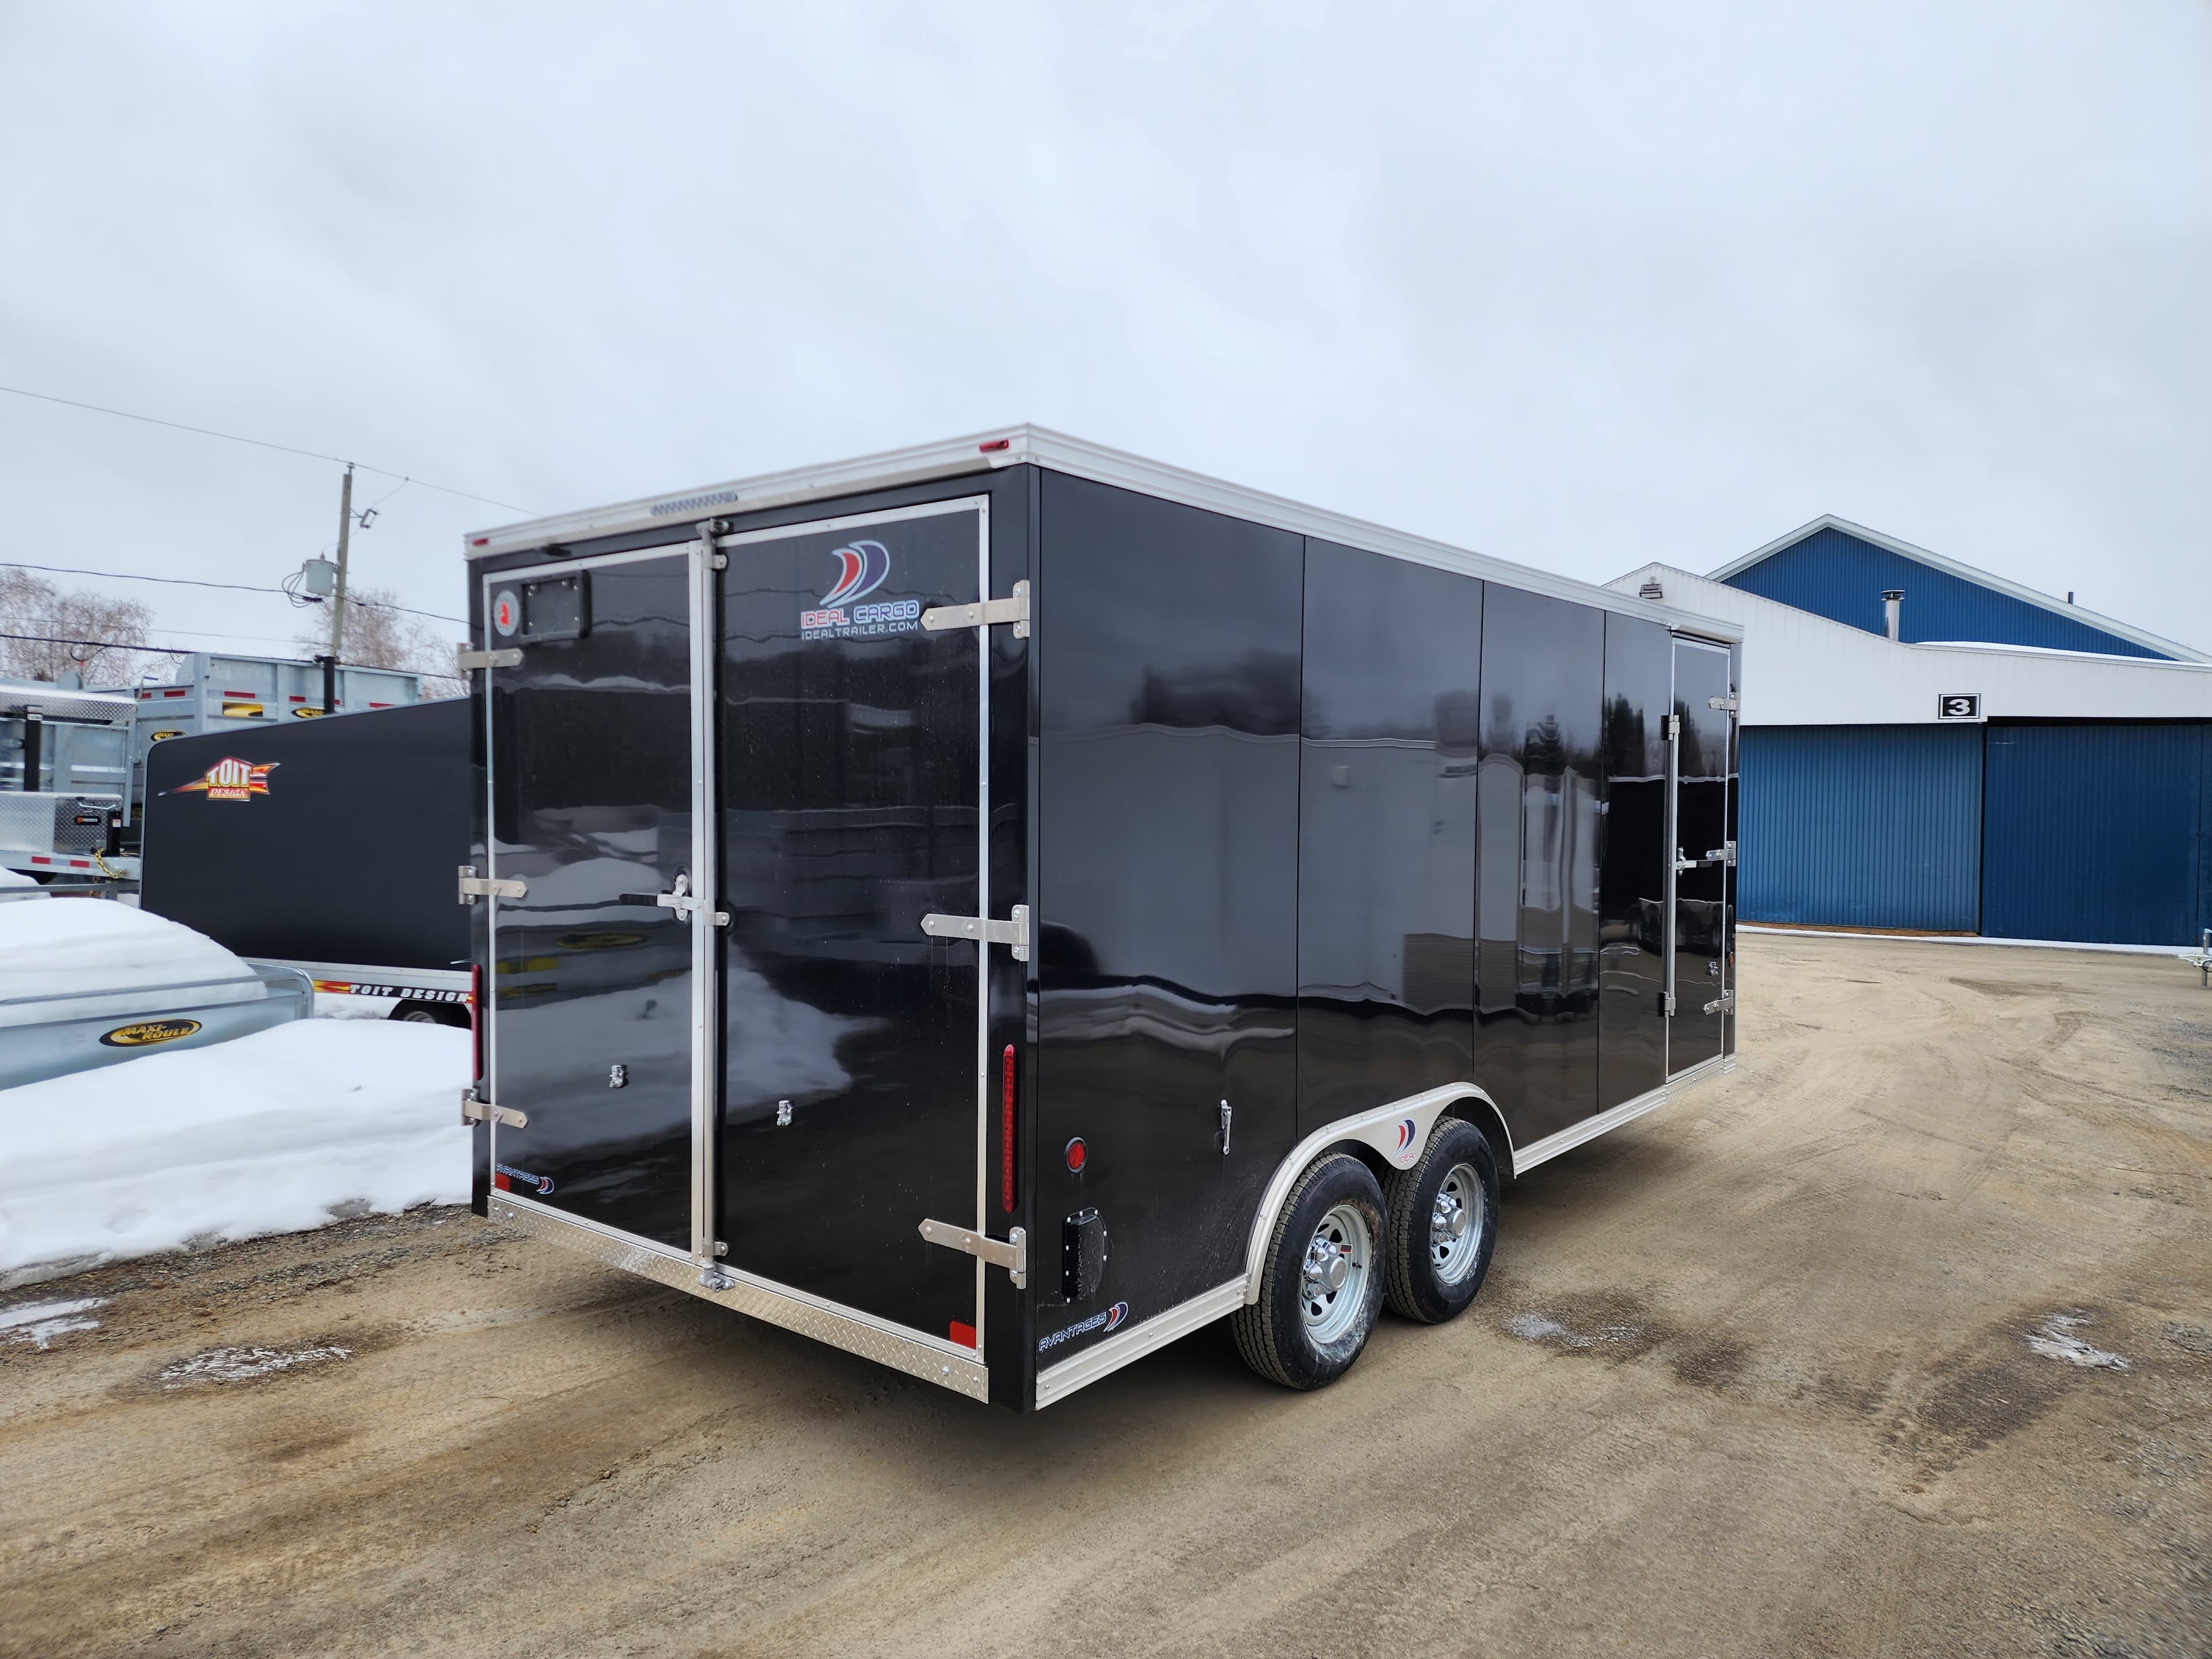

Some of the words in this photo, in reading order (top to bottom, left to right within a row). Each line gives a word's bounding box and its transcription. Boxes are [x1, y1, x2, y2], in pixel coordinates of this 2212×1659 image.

[800, 608, 850, 629] IDEAL
[853, 600, 919, 624] CARGO
[801, 620, 918, 641] IDEALTRAILER.COM
[1948, 699, 1971, 715] 3
[208, 759, 251, 785] TOIT
[210, 788, 245, 797] DESIGN
[350, 984, 393, 996] TOIT
[400, 988, 469, 1003] DESIGN
[142, 1027, 190, 1041] ROULE
[1039, 1312, 1107, 1352] AVANTAGES
